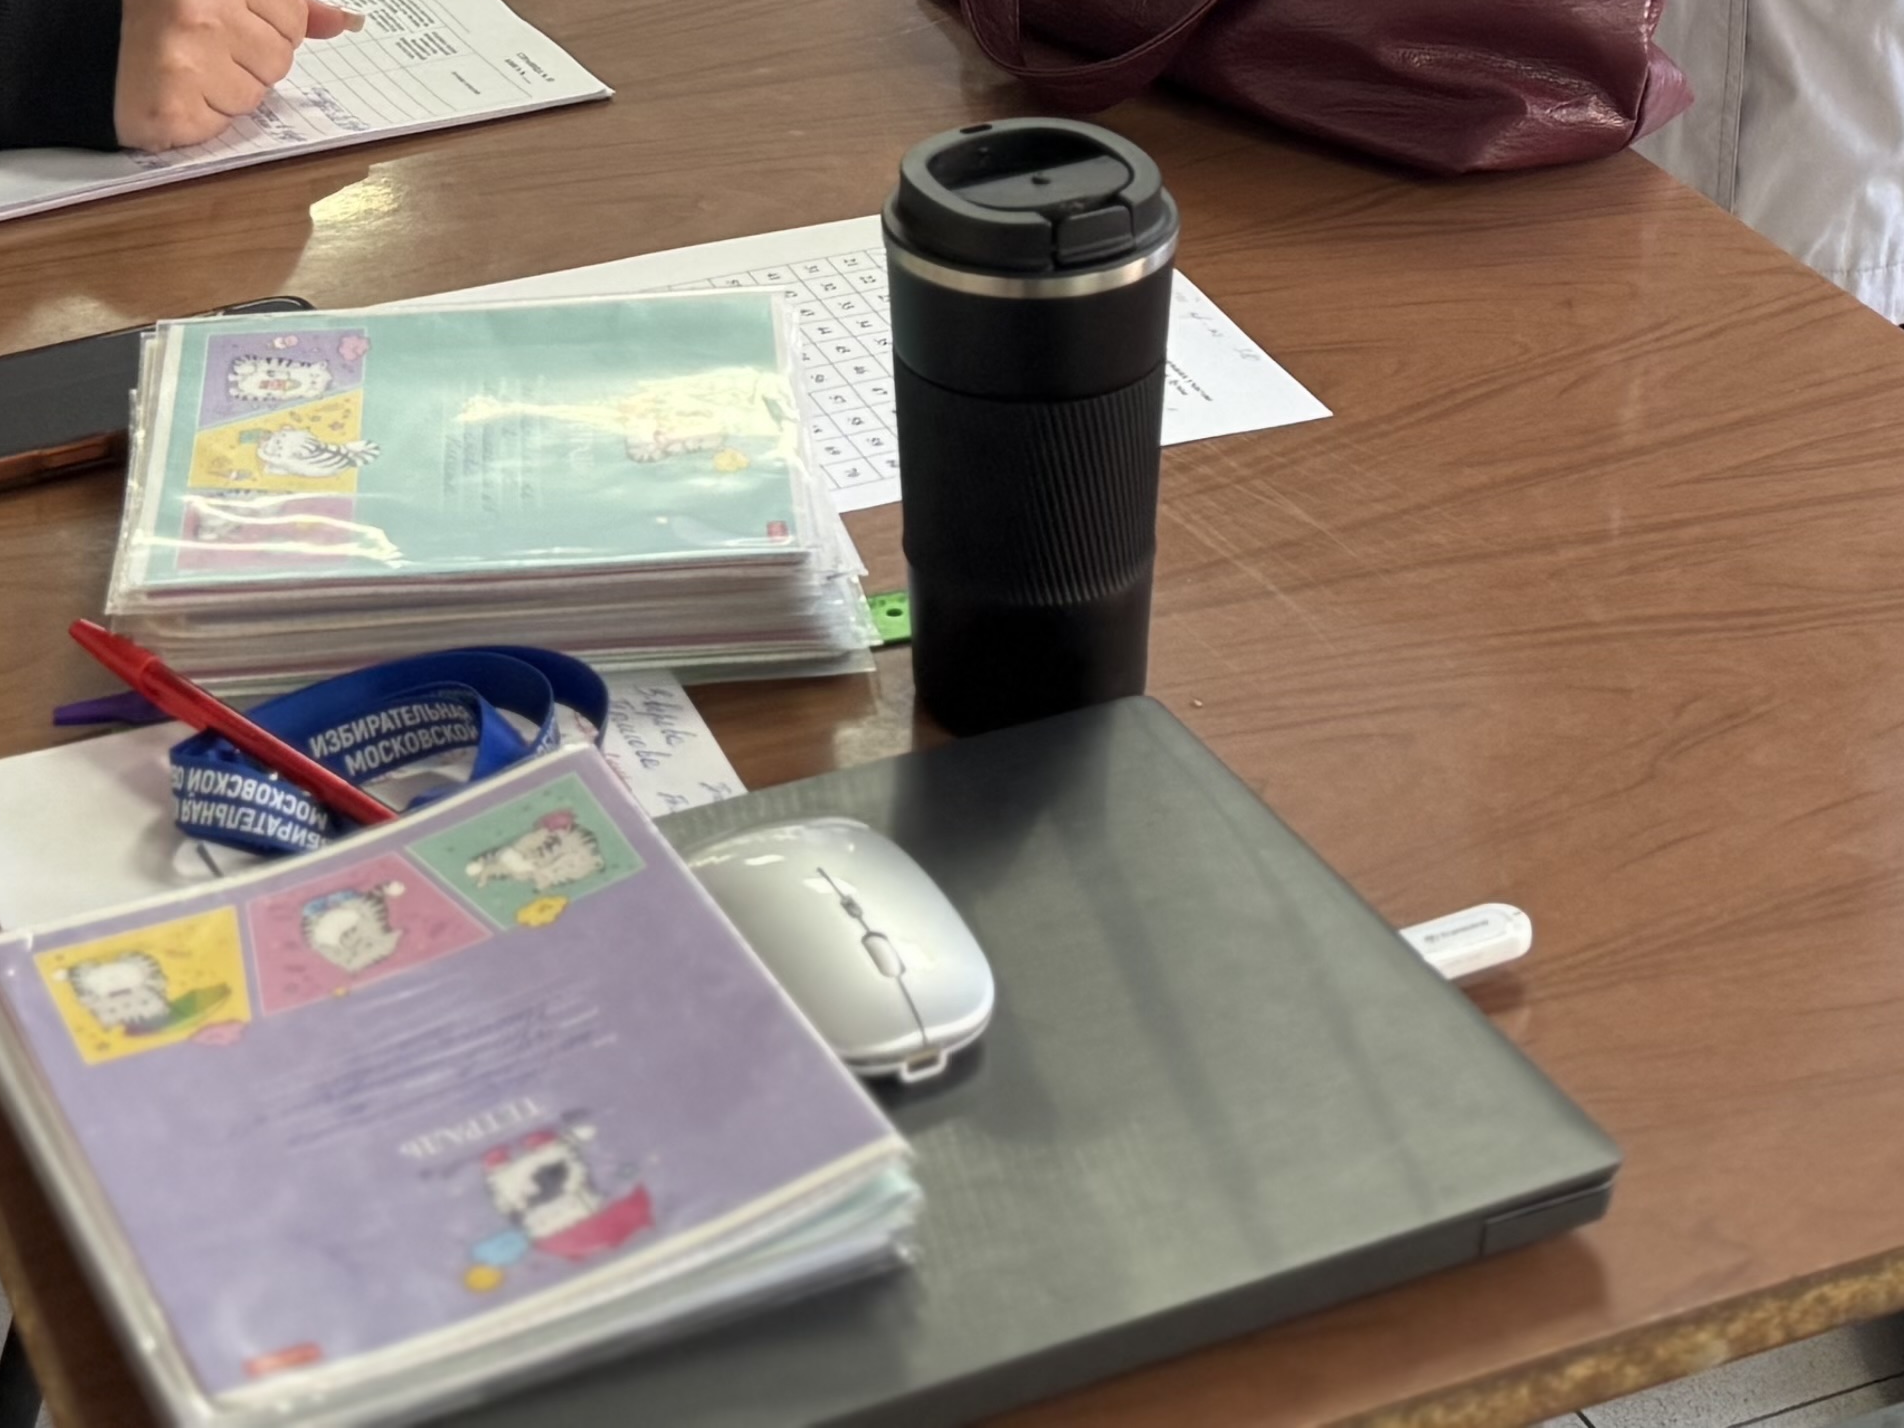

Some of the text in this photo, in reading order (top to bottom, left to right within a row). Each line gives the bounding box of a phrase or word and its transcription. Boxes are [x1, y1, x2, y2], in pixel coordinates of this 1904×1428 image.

[310, 703, 470, 758] ИЗБИРАТЕЛЬНАЯ
[343, 723, 479, 777] МОСКОВСКОЙ
[186, 763, 330, 831] МОСКОВСКОЙ
[183, 799, 333, 851] БИРАТЕЛЬНАЯ
